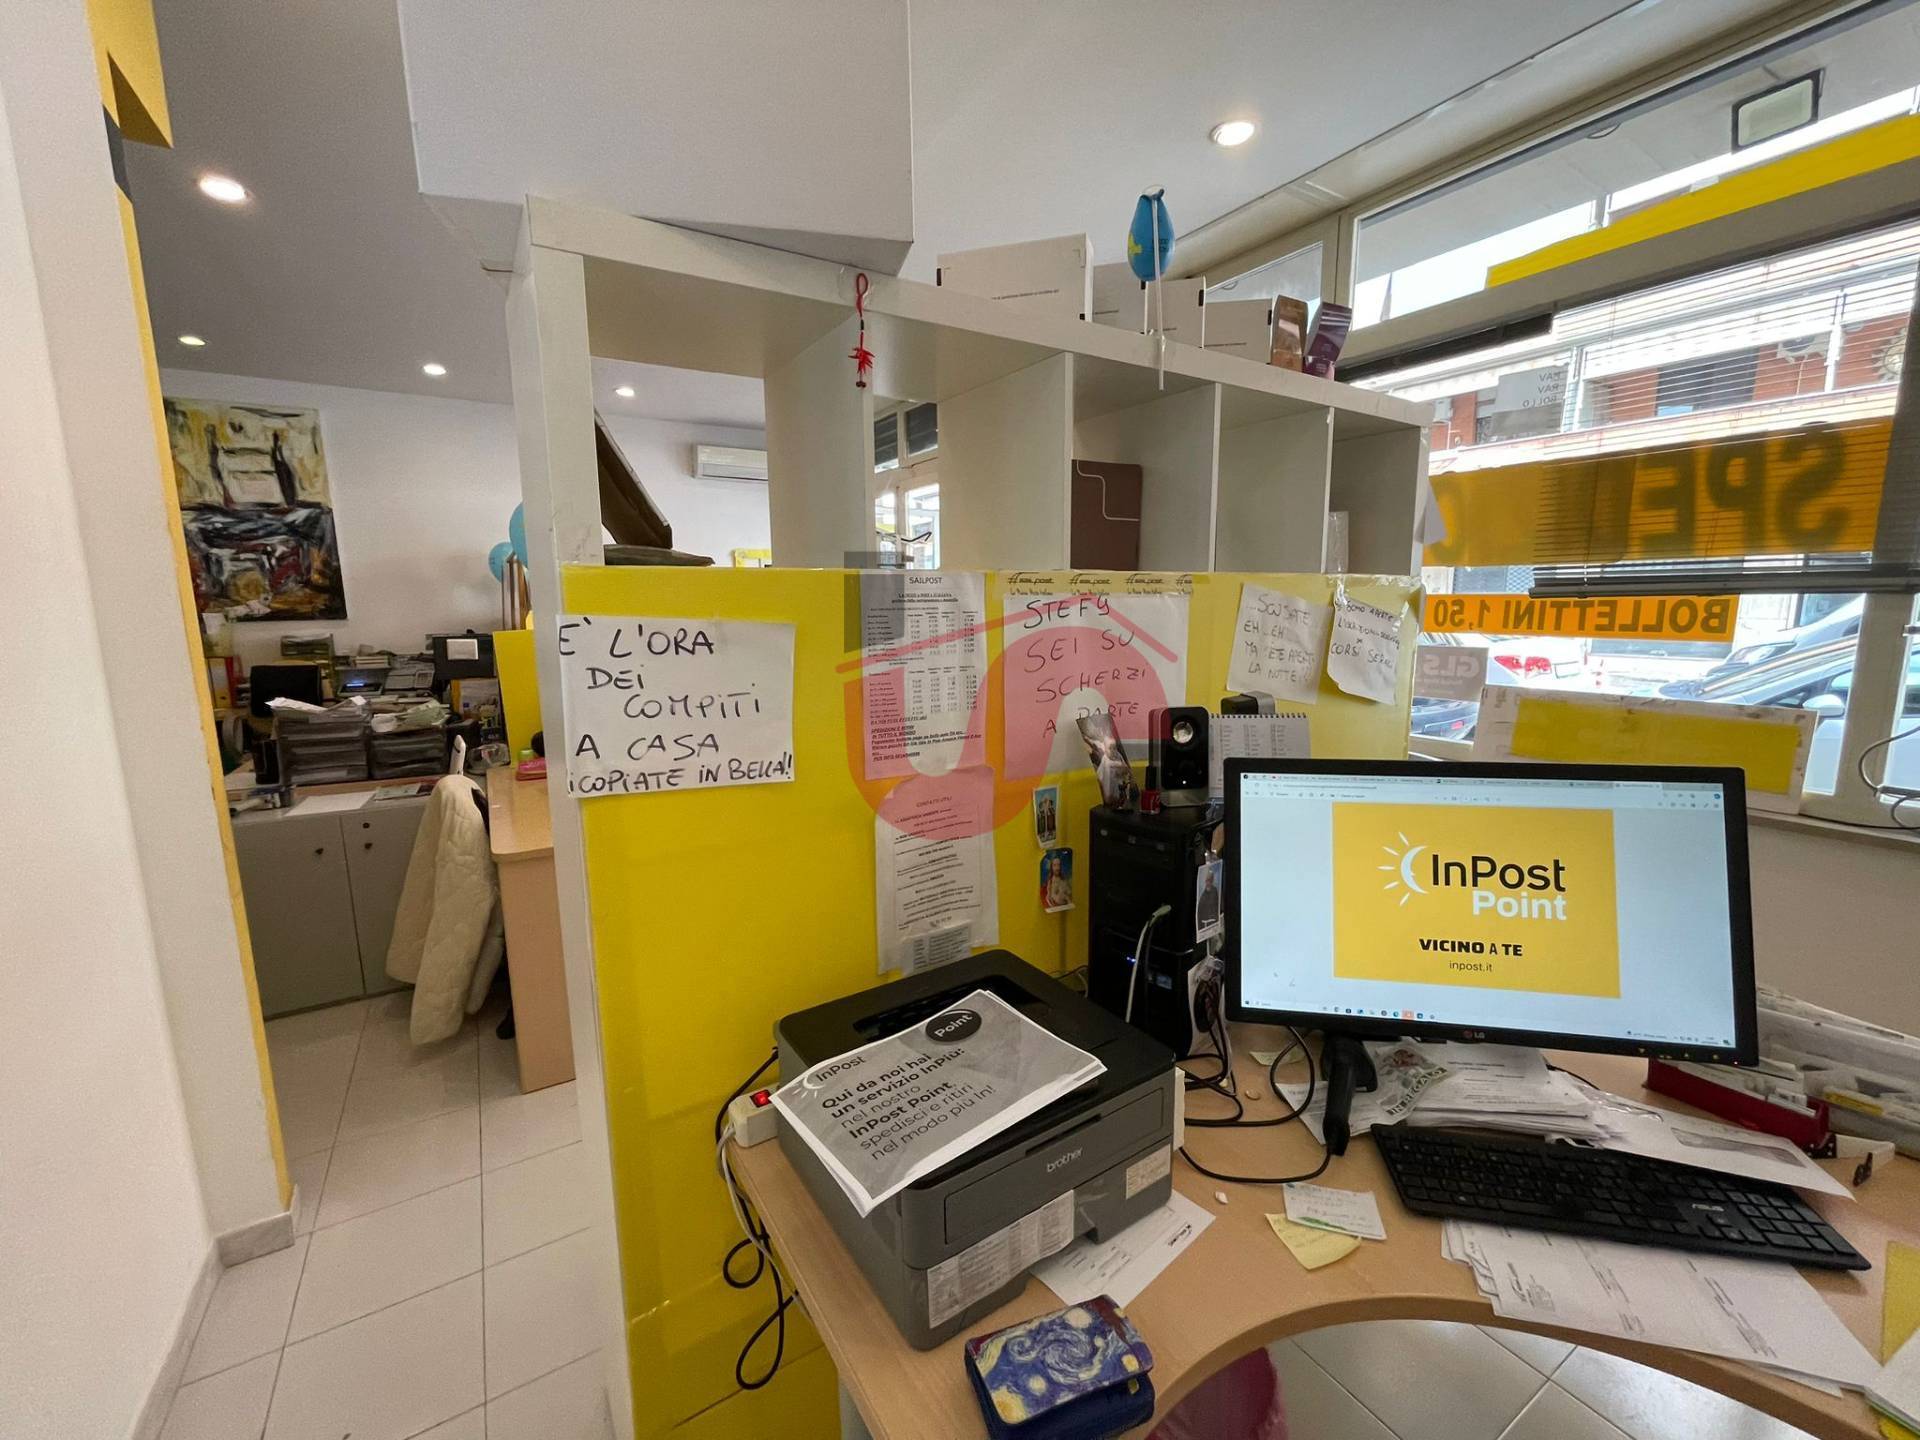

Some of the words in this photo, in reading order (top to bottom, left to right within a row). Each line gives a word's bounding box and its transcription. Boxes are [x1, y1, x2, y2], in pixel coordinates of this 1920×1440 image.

[909, 577, 943, 585] SAILPOST
[609, 624, 715, 658] L'ORA
[1024, 638, 1077, 673] SEI
[1101, 629, 1135, 650] SU
[1035, 667, 1146, 703] SCHERZI
[575, 734, 600, 759] A
[627, 734, 720, 761] CASA
[1432, 854, 1566, 892] InPost
[1472, 890, 1567, 920] Point
[1419, 939, 1485, 954] VICINO
[1489, 943, 1498, 955] A
[1501, 944, 1523, 956] TE
[1449, 960, 1492, 972] inpost.it
[934, 1014, 973, 1037] Point
[1474, 1031, 1486, 1039] LG
[815, 1055, 867, 1082] InPost
[822, 1088, 853, 1109] Qui
[856, 1079, 877, 1092] da
[880, 1065, 905, 1082] noi
[907, 1054, 932, 1069] hai
[831, 1104, 856, 1119] un
[858, 1073, 920, 1105] servizio
[841, 1110, 868, 1128] nel
[870, 1086, 921, 1113] nostro
[849, 1105, 908, 1139] InPost
[860, 1108, 928, 1150] spedisci
[929, 1103, 941, 1112] e
[871, 1140, 899, 1160] nel
[900, 1115, 948, 1144] modo
[1046, 1148, 1084, 1173] brother
